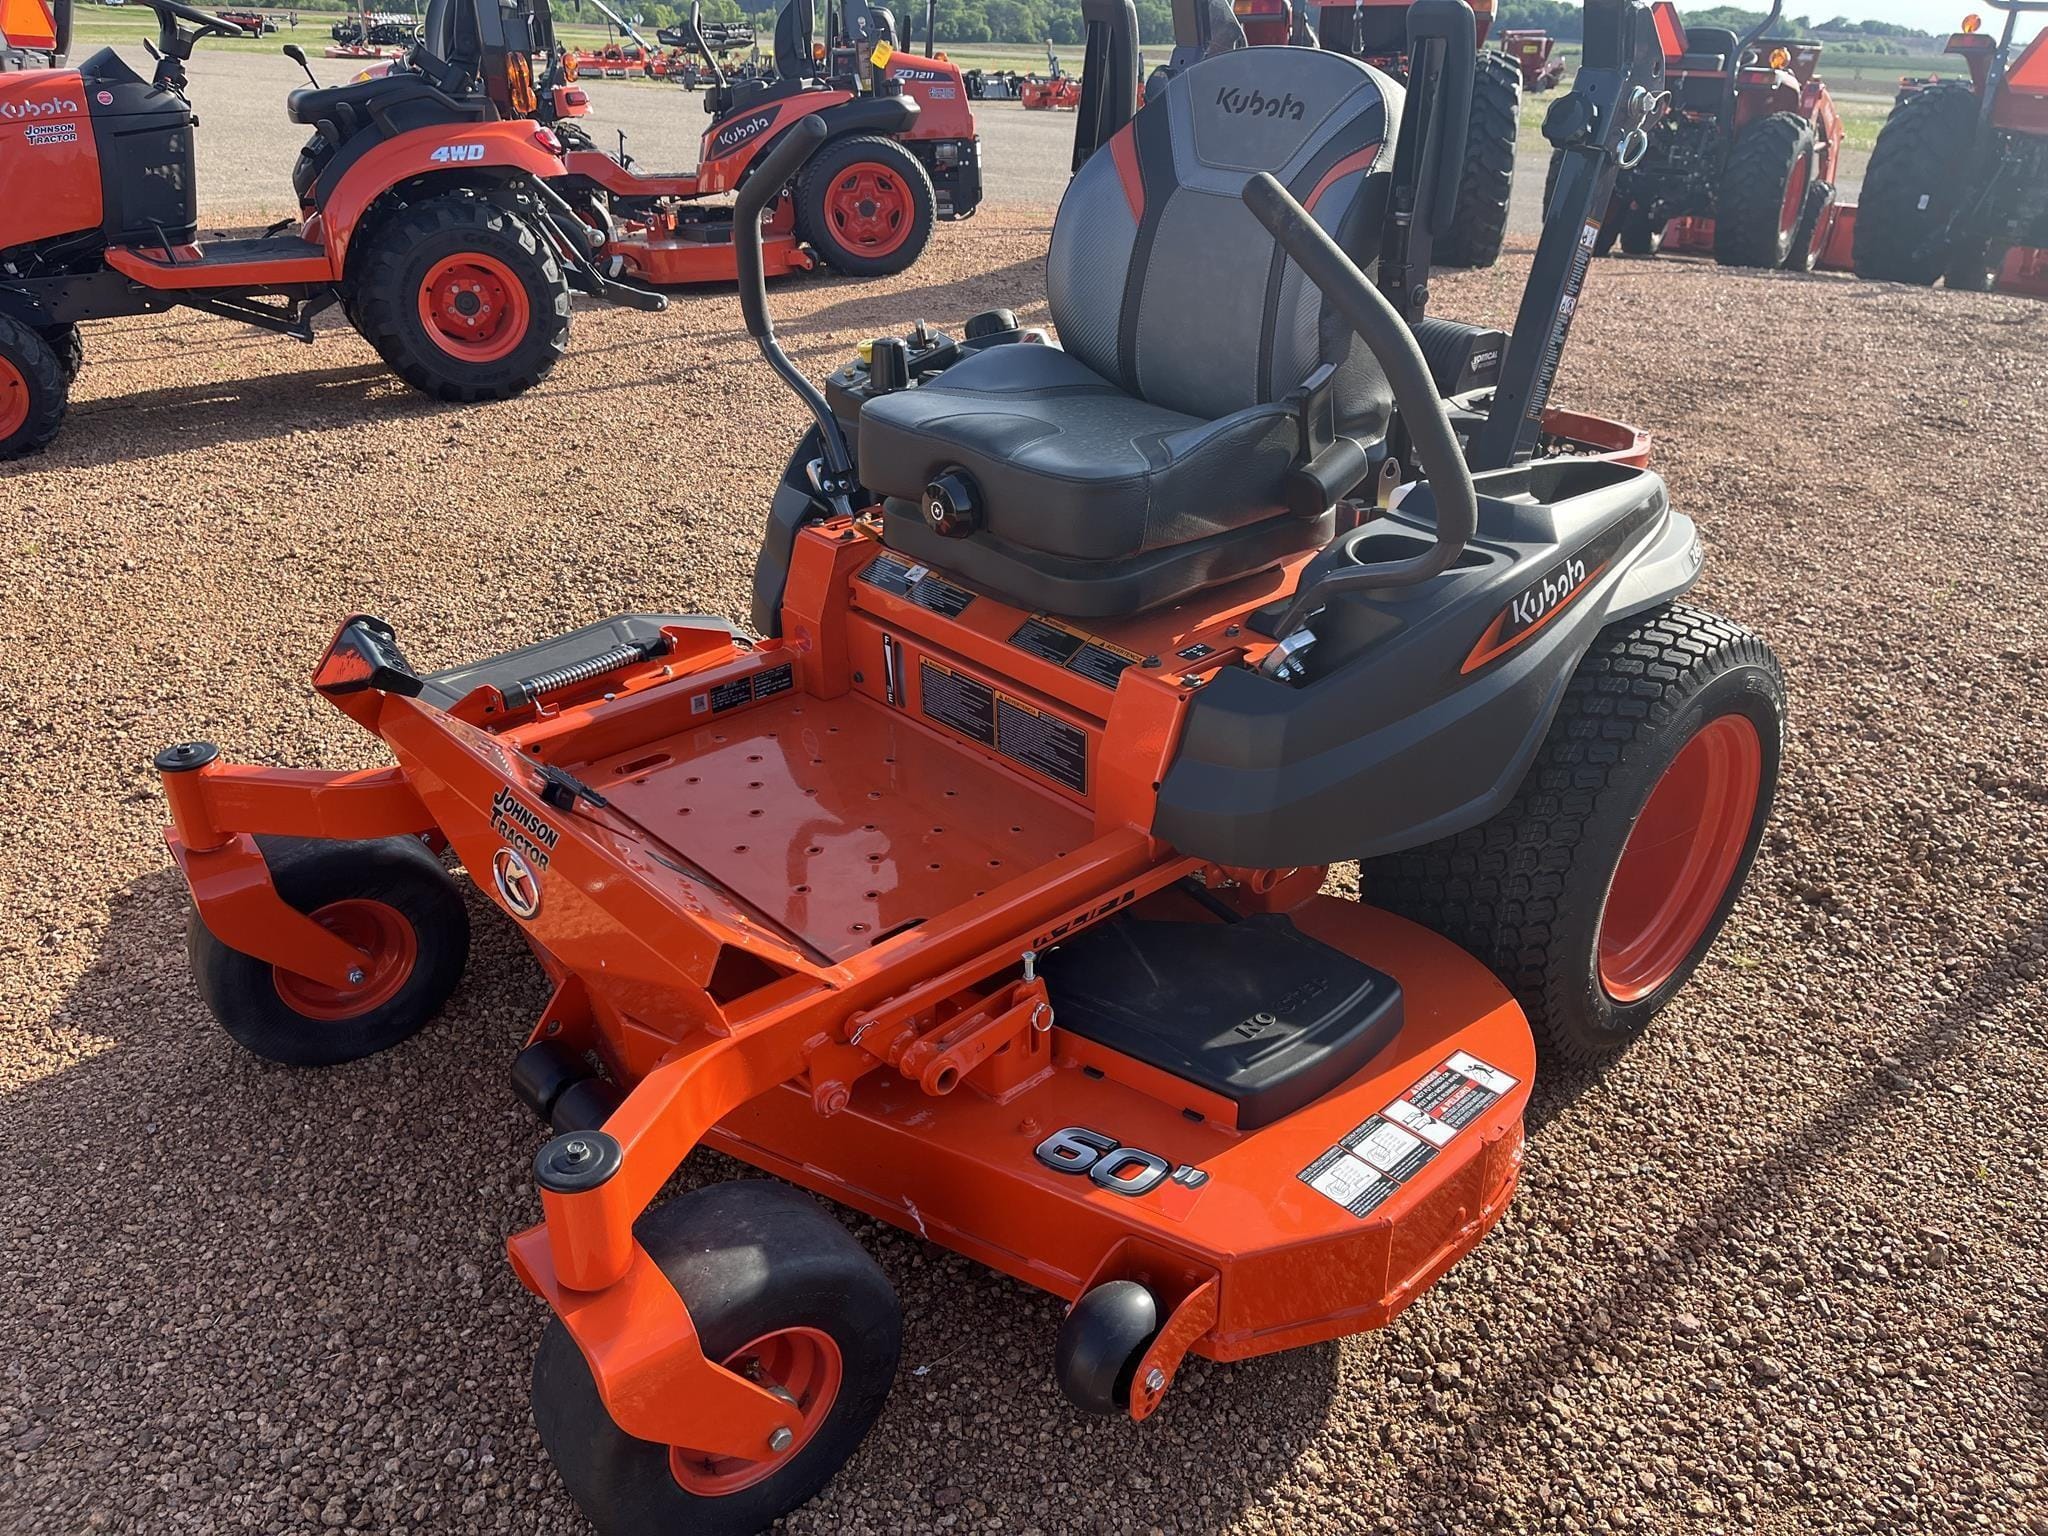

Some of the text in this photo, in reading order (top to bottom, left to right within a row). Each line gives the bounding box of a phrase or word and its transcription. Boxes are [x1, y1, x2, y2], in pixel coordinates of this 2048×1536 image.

[1215, 87, 1305, 121] Kubota
[25, 123, 75, 136] JOHNSON
[27, 134, 77, 145] TRACTOR
[719, 118, 769, 145] Kubota
[430, 144, 485, 162] 4WD
[1512, 559, 1586, 624] Kubota
[884, 635, 890, 644] F
[888, 693, 894, 703] E
[493, 786, 560, 850] JOHNSON
[490, 806, 549, 871] TRACTOR
[1233, 1012, 1276, 1039] NO
